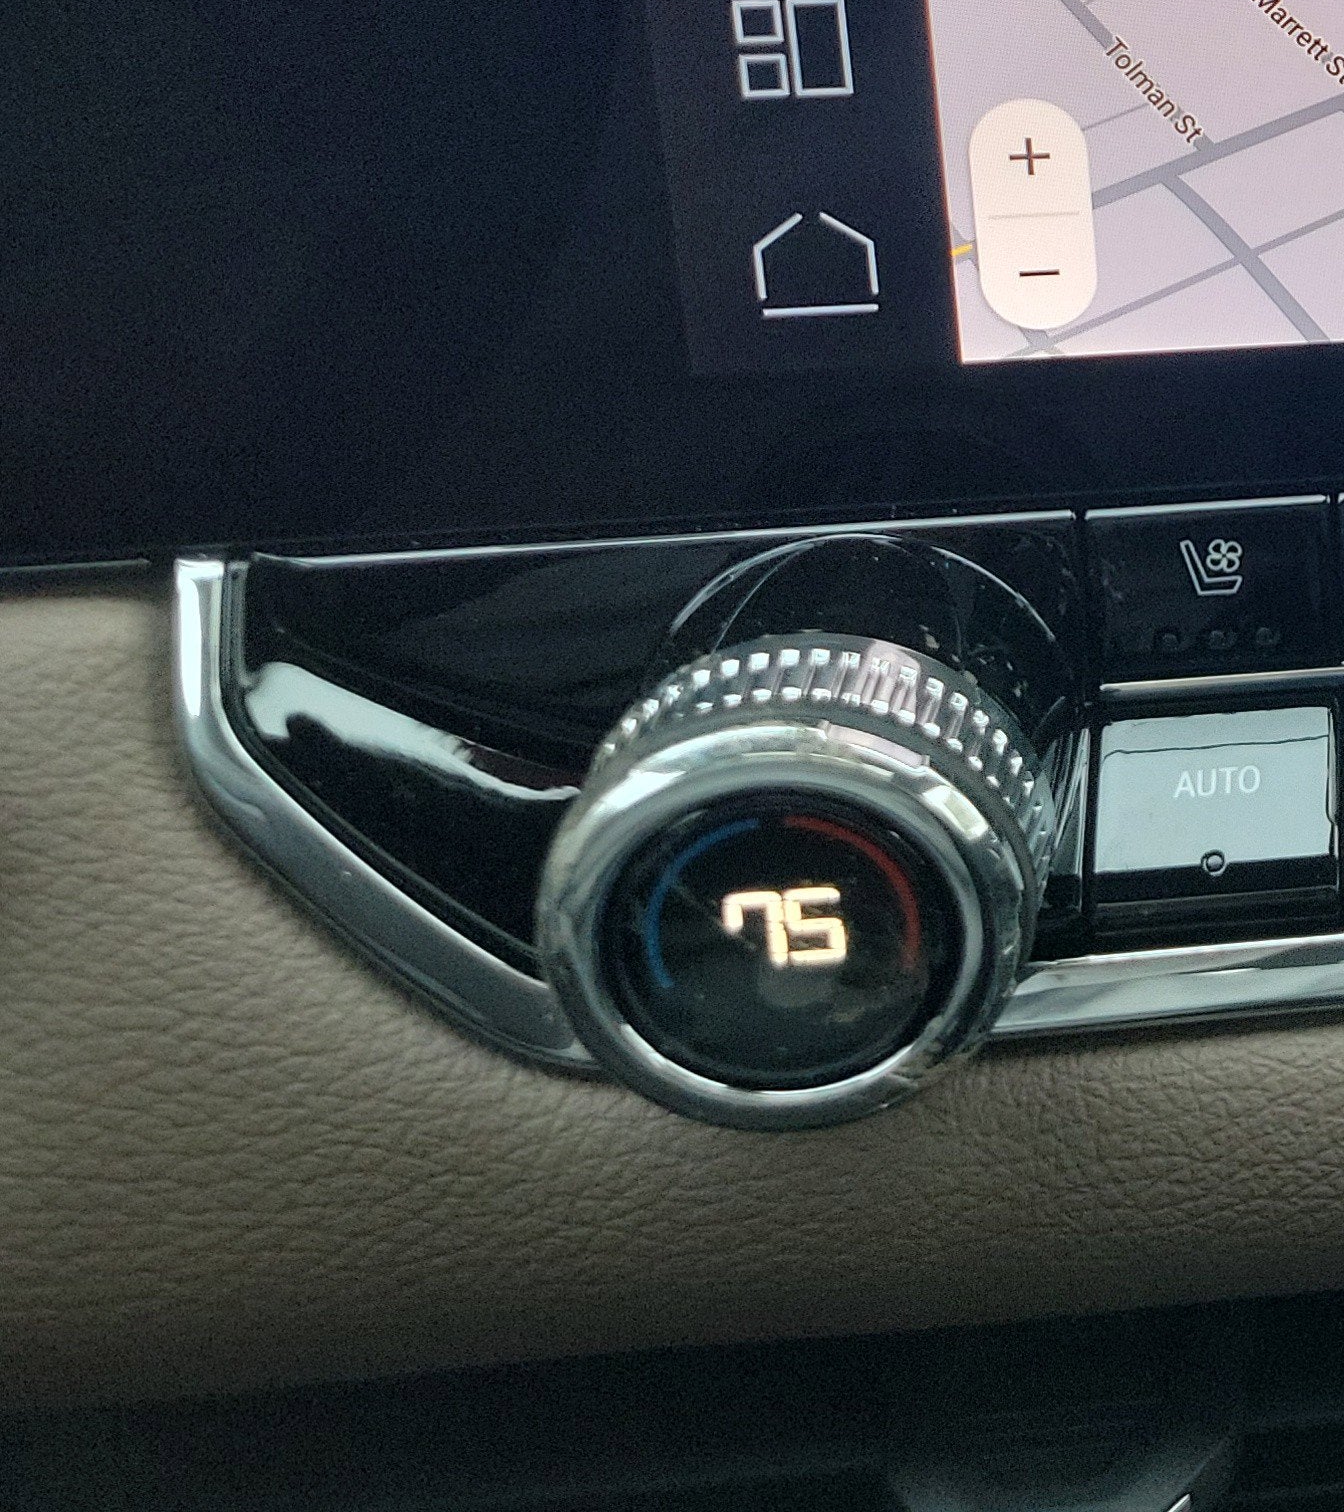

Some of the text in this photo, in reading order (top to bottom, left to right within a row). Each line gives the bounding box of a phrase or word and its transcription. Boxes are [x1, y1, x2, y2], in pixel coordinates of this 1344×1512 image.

[1106, 36, 1204, 144] Tolman St
[1174, 765, 1261, 798] AUTO
[724, 887, 847, 967] 75
